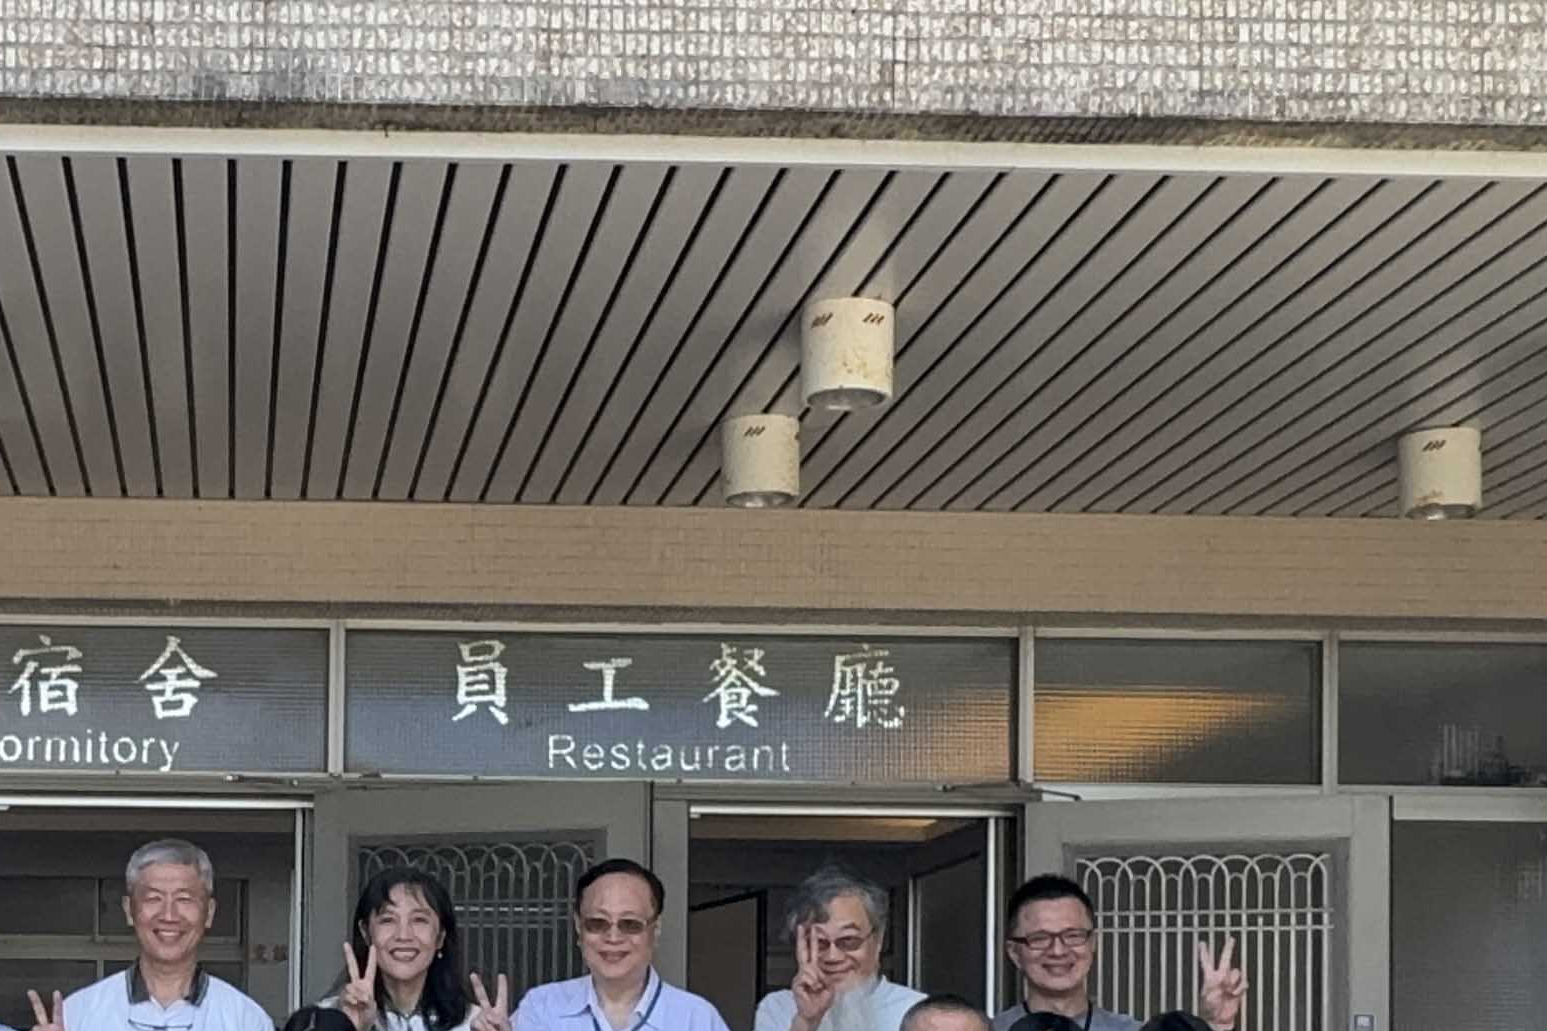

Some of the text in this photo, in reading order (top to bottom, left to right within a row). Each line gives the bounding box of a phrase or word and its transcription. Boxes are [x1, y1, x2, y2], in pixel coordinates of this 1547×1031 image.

[452, 639, 908, 731] 員工餐廳
[548, 735, 791, 775] Restaurant
